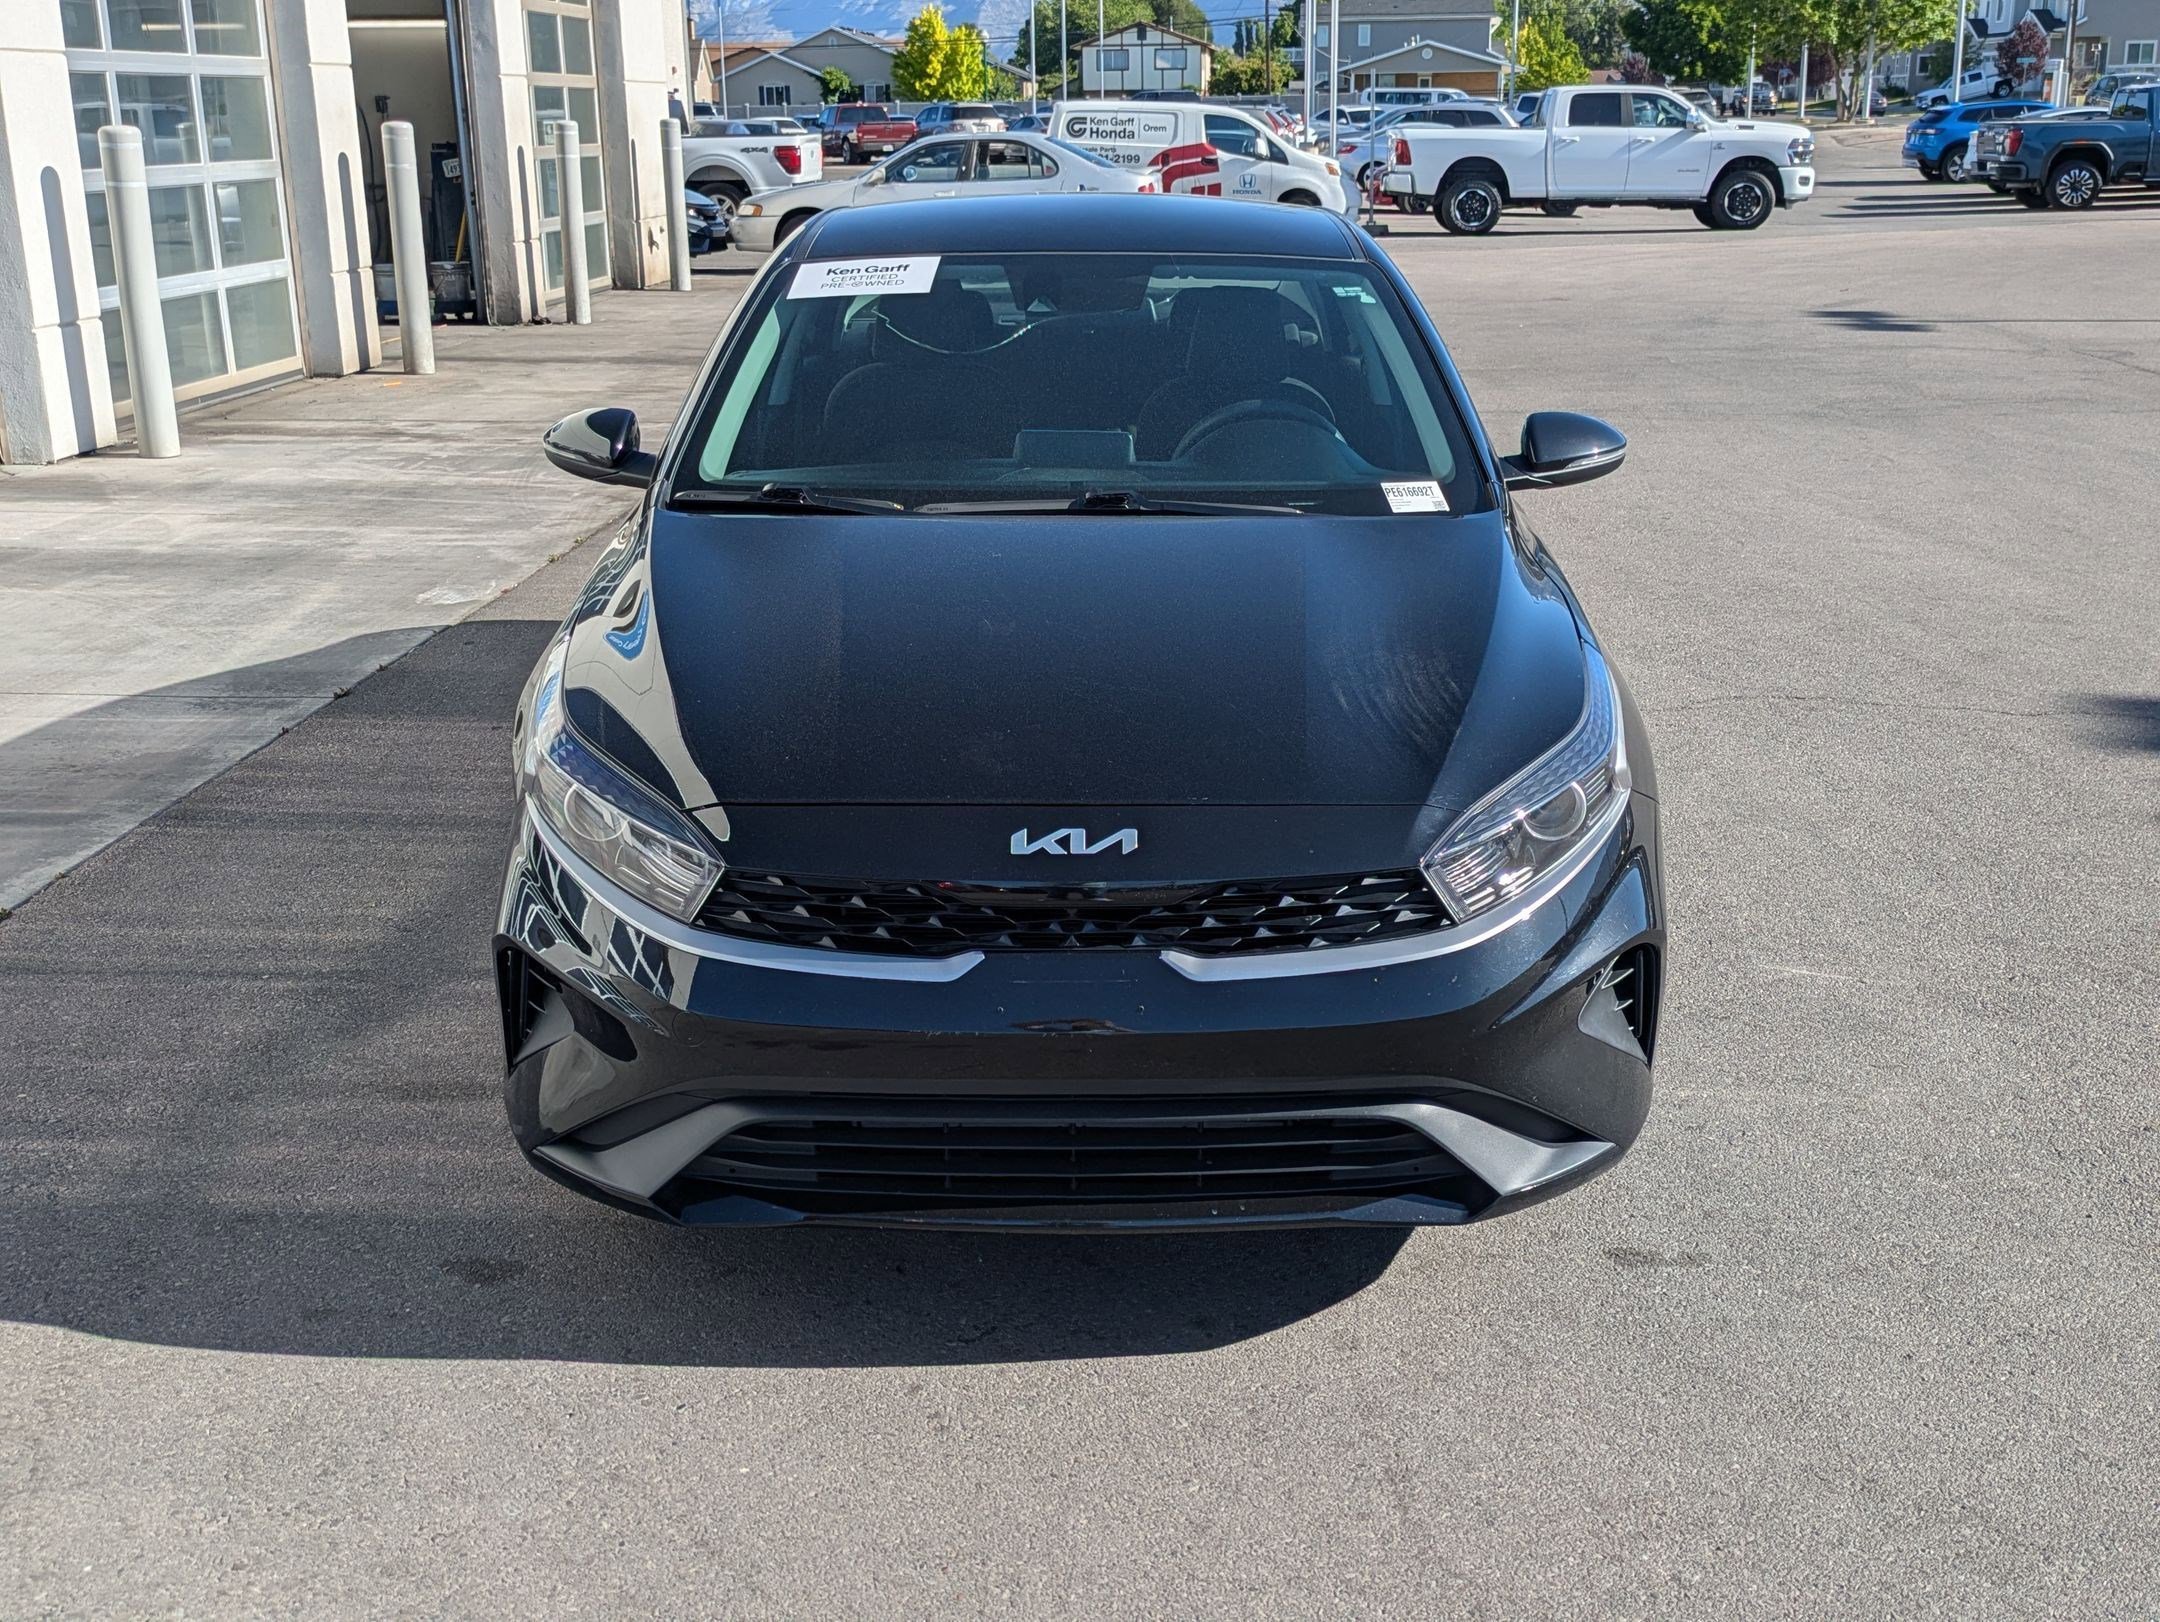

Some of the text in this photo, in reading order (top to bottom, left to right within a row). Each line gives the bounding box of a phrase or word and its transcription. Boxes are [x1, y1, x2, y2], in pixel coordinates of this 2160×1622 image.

[1089, 117, 1135, 126] Ken Garff
[1089, 127, 1135, 139] Honda
[1143, 124, 1167, 132] Orem
[826, 264, 911, 276] Ken Garff
[831, 273, 898, 283] CERTIFIED
